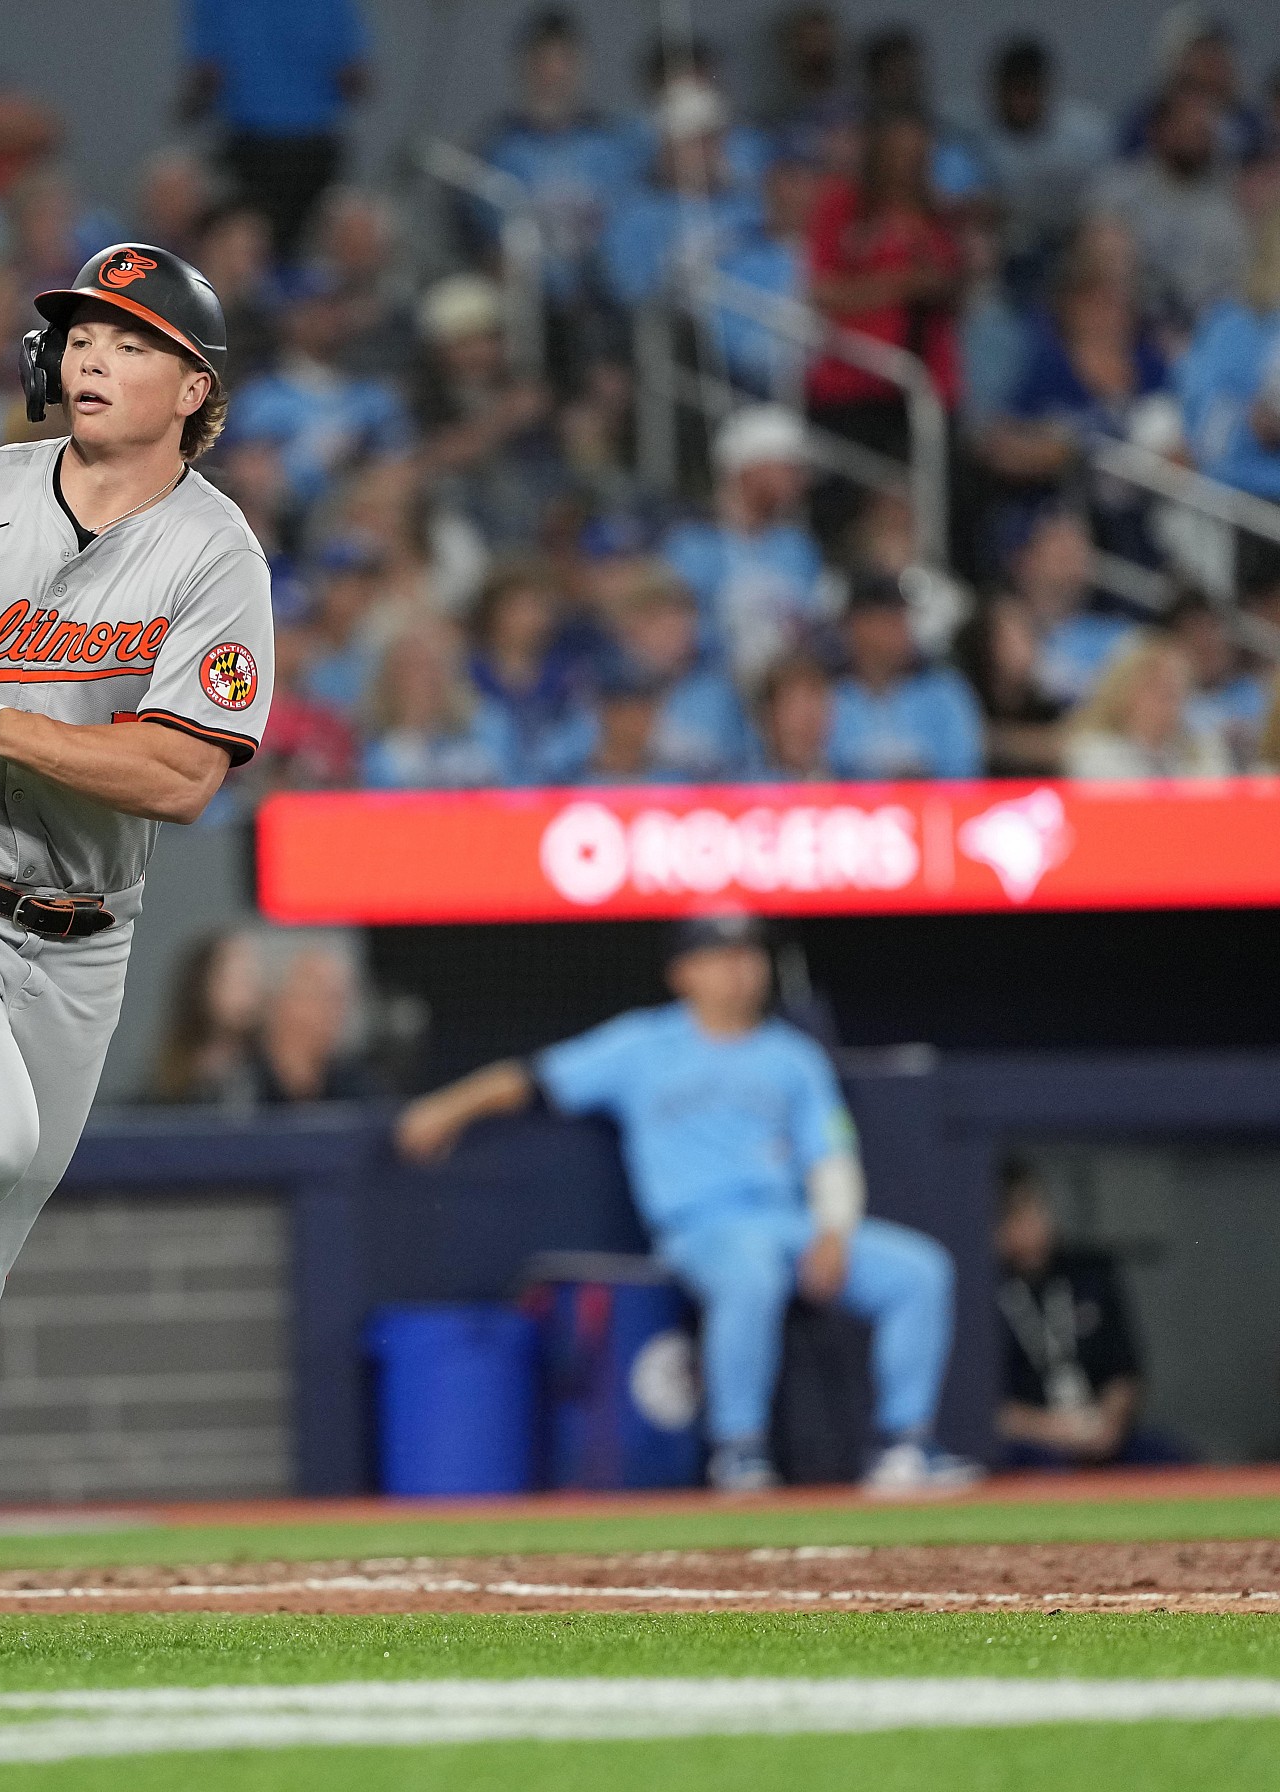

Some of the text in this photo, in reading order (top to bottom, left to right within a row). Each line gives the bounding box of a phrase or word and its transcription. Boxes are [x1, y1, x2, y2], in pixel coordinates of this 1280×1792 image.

[209, 645, 257, 677] BALTIMORE
[206, 687, 247, 708] ORIOLES
[629, 805, 918, 892] ROGERS
